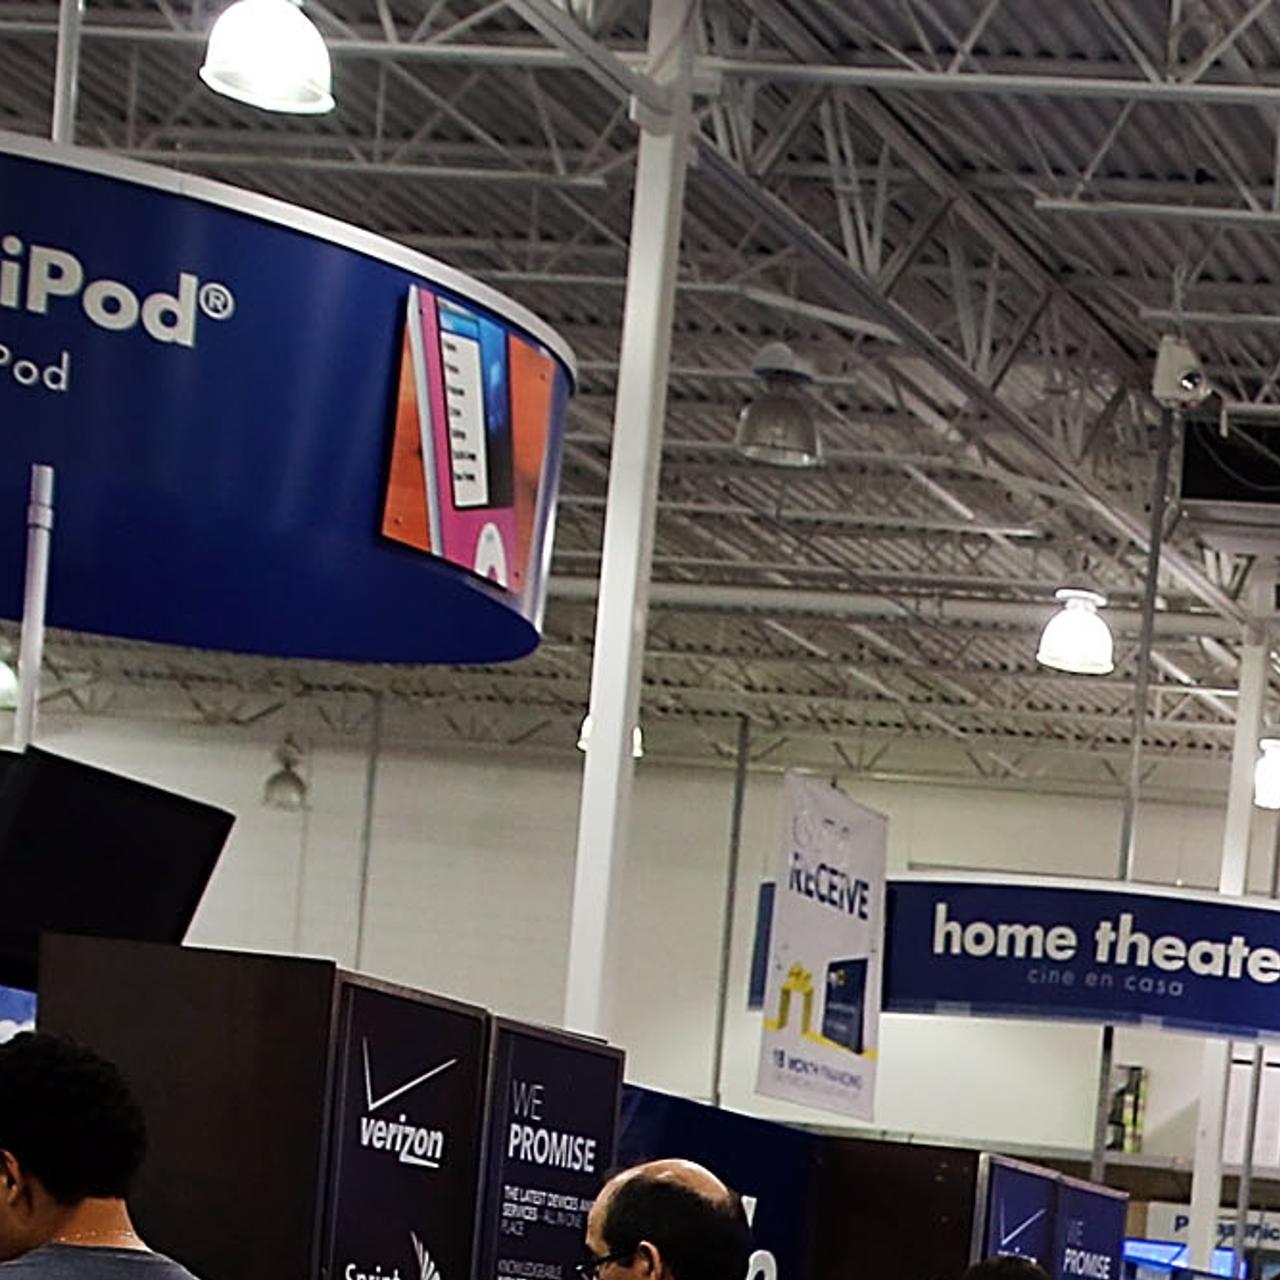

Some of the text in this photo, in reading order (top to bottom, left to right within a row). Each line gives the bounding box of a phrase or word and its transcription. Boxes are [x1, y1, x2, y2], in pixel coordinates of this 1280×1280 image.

[789, 851, 870, 921] RECEIVE
[932, 903, 1078, 961] home
[1027, 966, 1184, 997] cine en casa
[511, 1078, 545, 1121] WE
[360, 1113, 444, 1168] verizon
[507, 1122, 597, 1173] PROMISE
[1062, 1247, 1112, 1280] PROMISE
